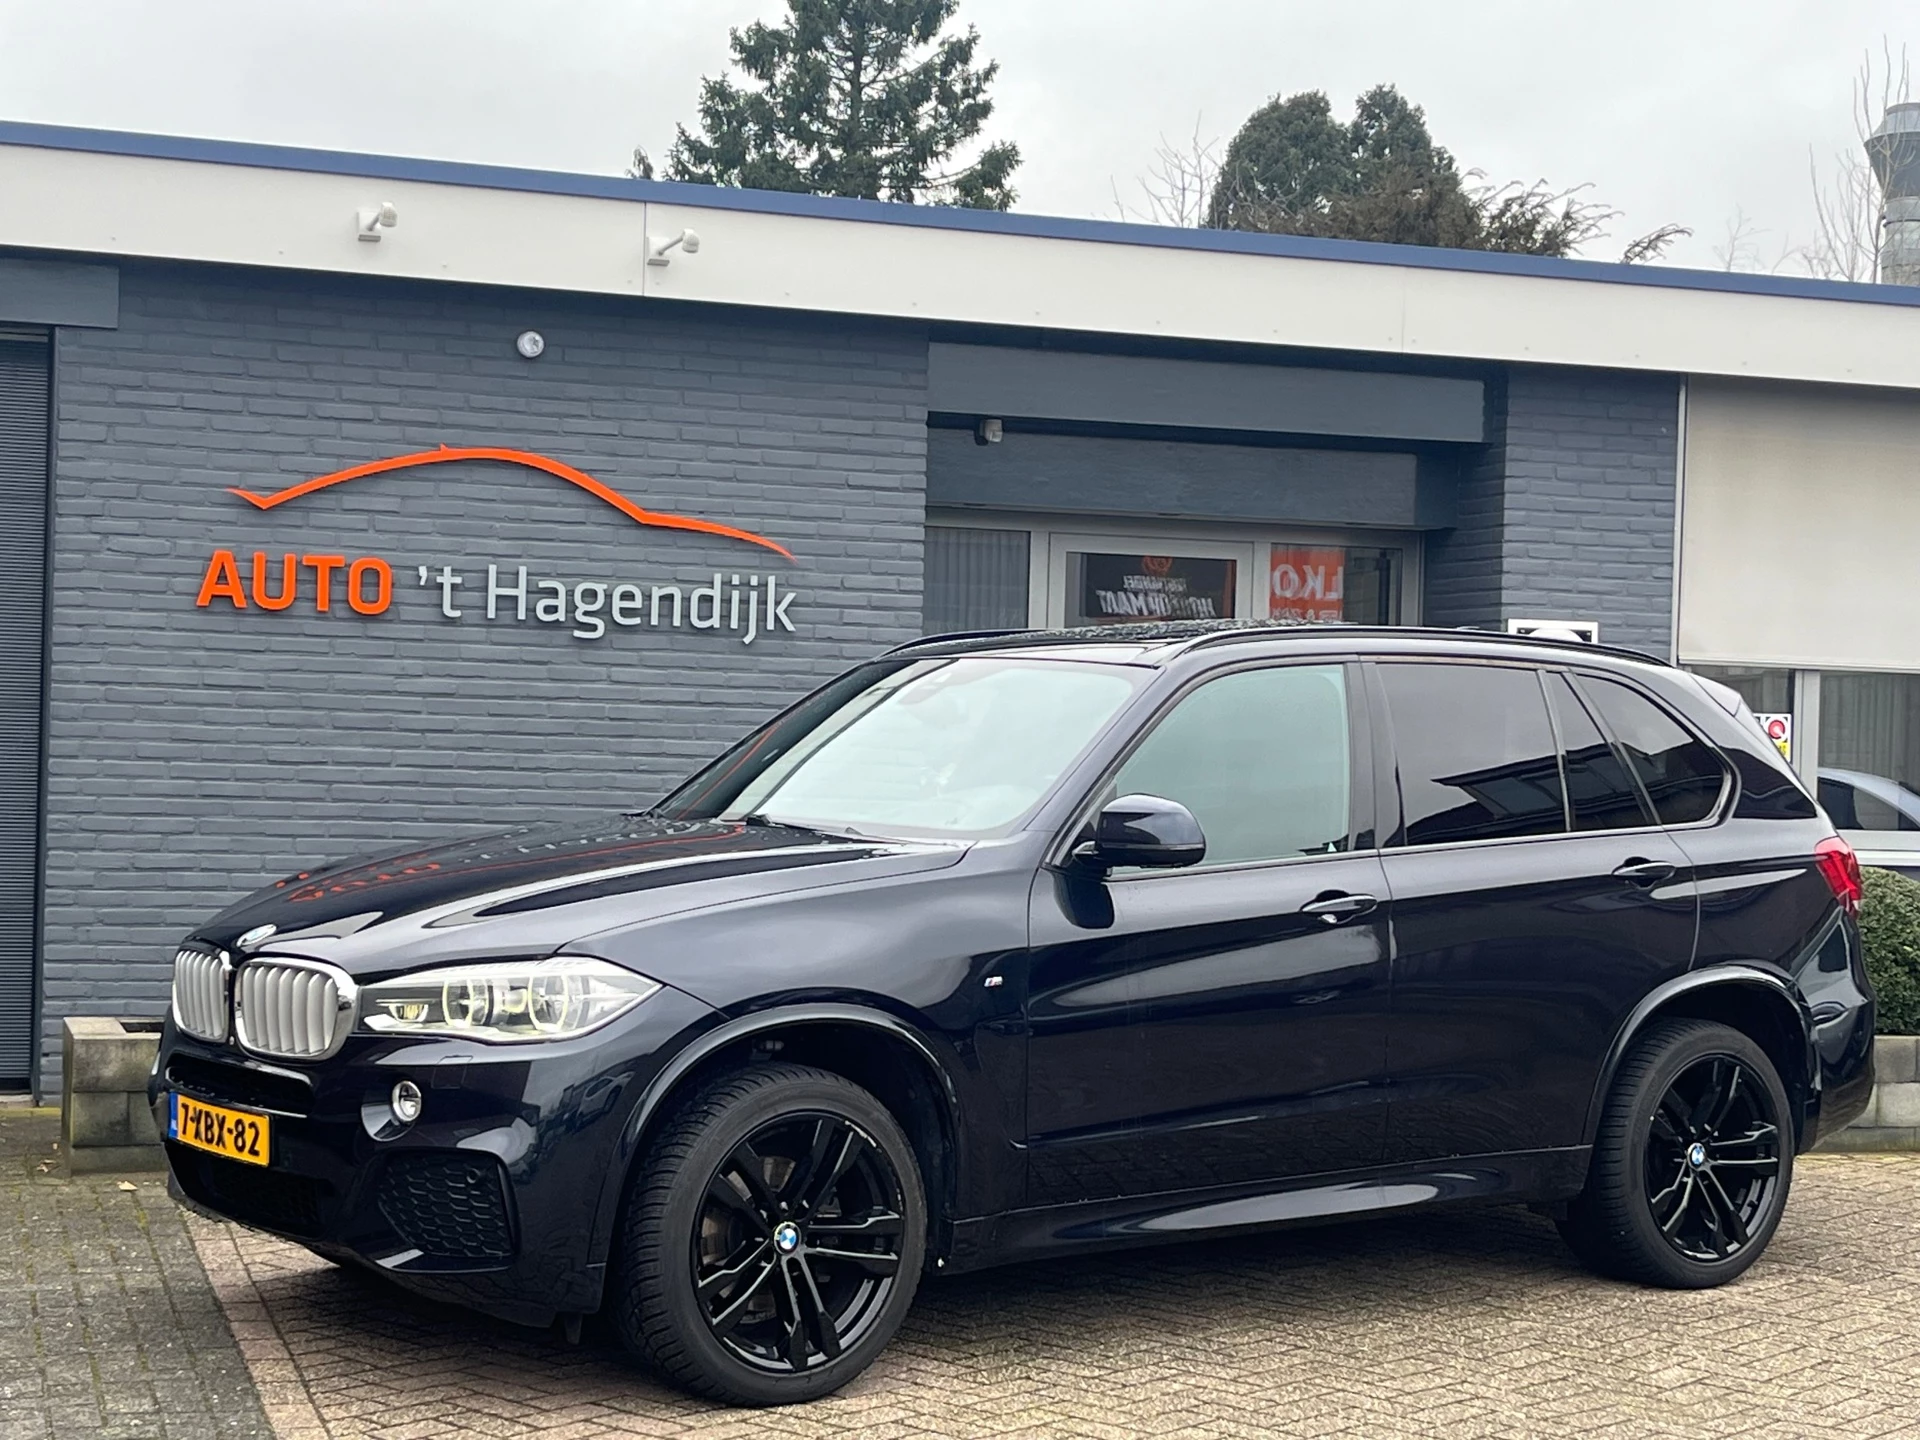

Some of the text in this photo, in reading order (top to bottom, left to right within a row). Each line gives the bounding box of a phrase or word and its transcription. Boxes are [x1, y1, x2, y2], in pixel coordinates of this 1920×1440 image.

[196, 549, 393, 615] AUTO
[486, 565, 797, 645] Hagendijk
[181, 1102, 260, 1157] 7-XBX-82
